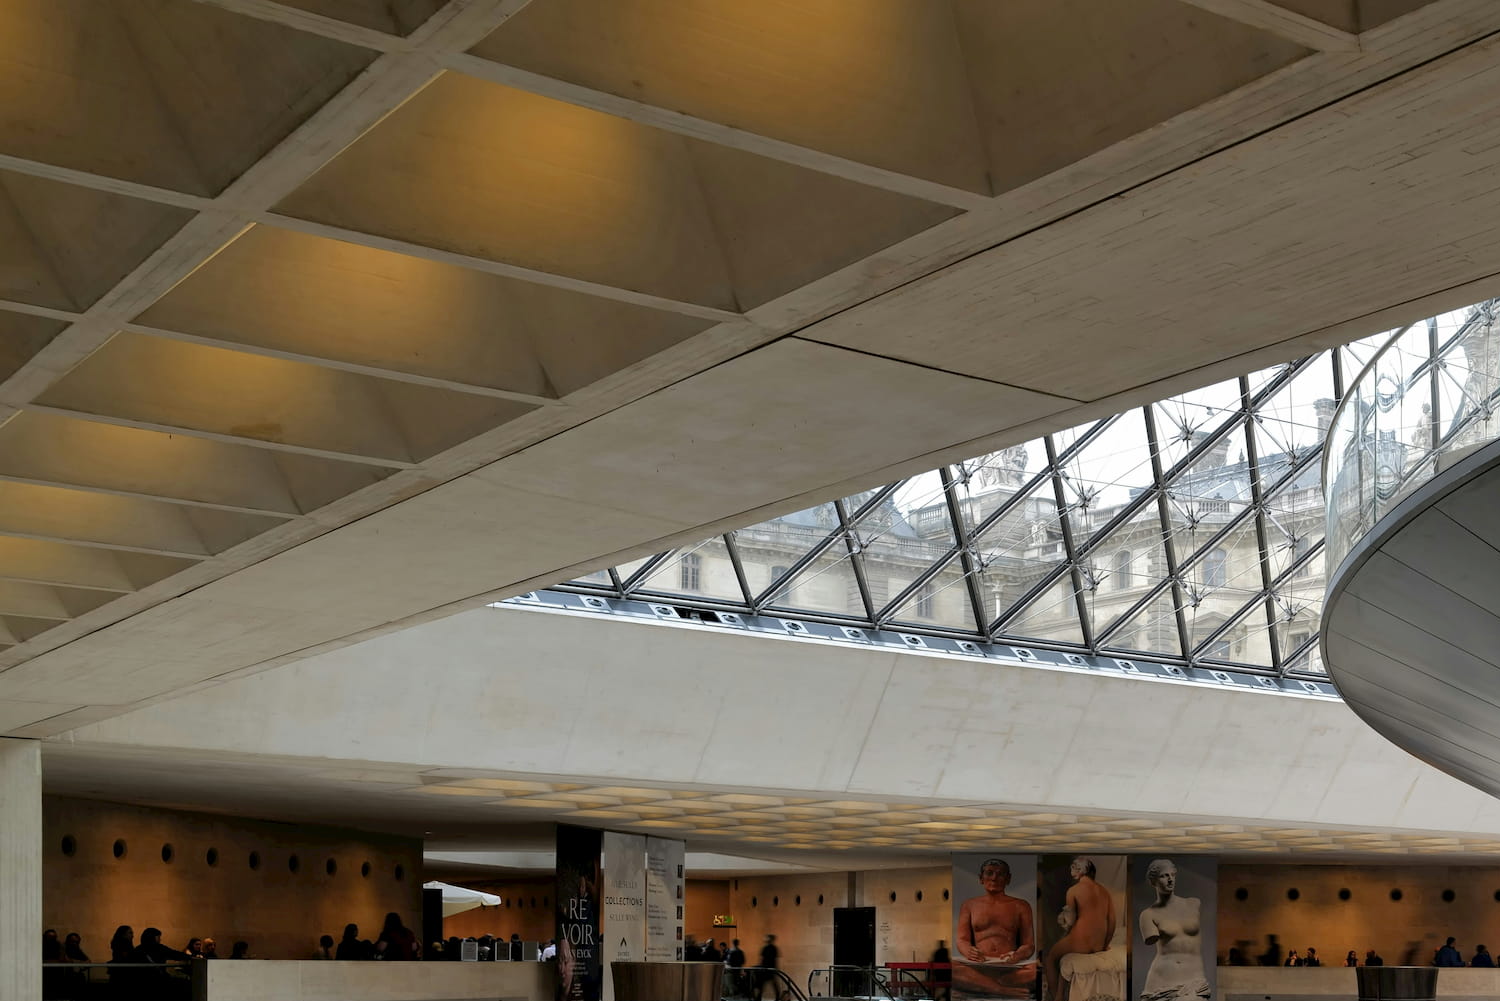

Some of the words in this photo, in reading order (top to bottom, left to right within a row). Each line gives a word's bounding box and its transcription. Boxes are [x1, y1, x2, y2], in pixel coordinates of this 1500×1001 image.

[569, 898, 588, 920] RE
[605, 896, 643, 906] COLLECTIONS
[562, 923, 594, 945] VOIR
